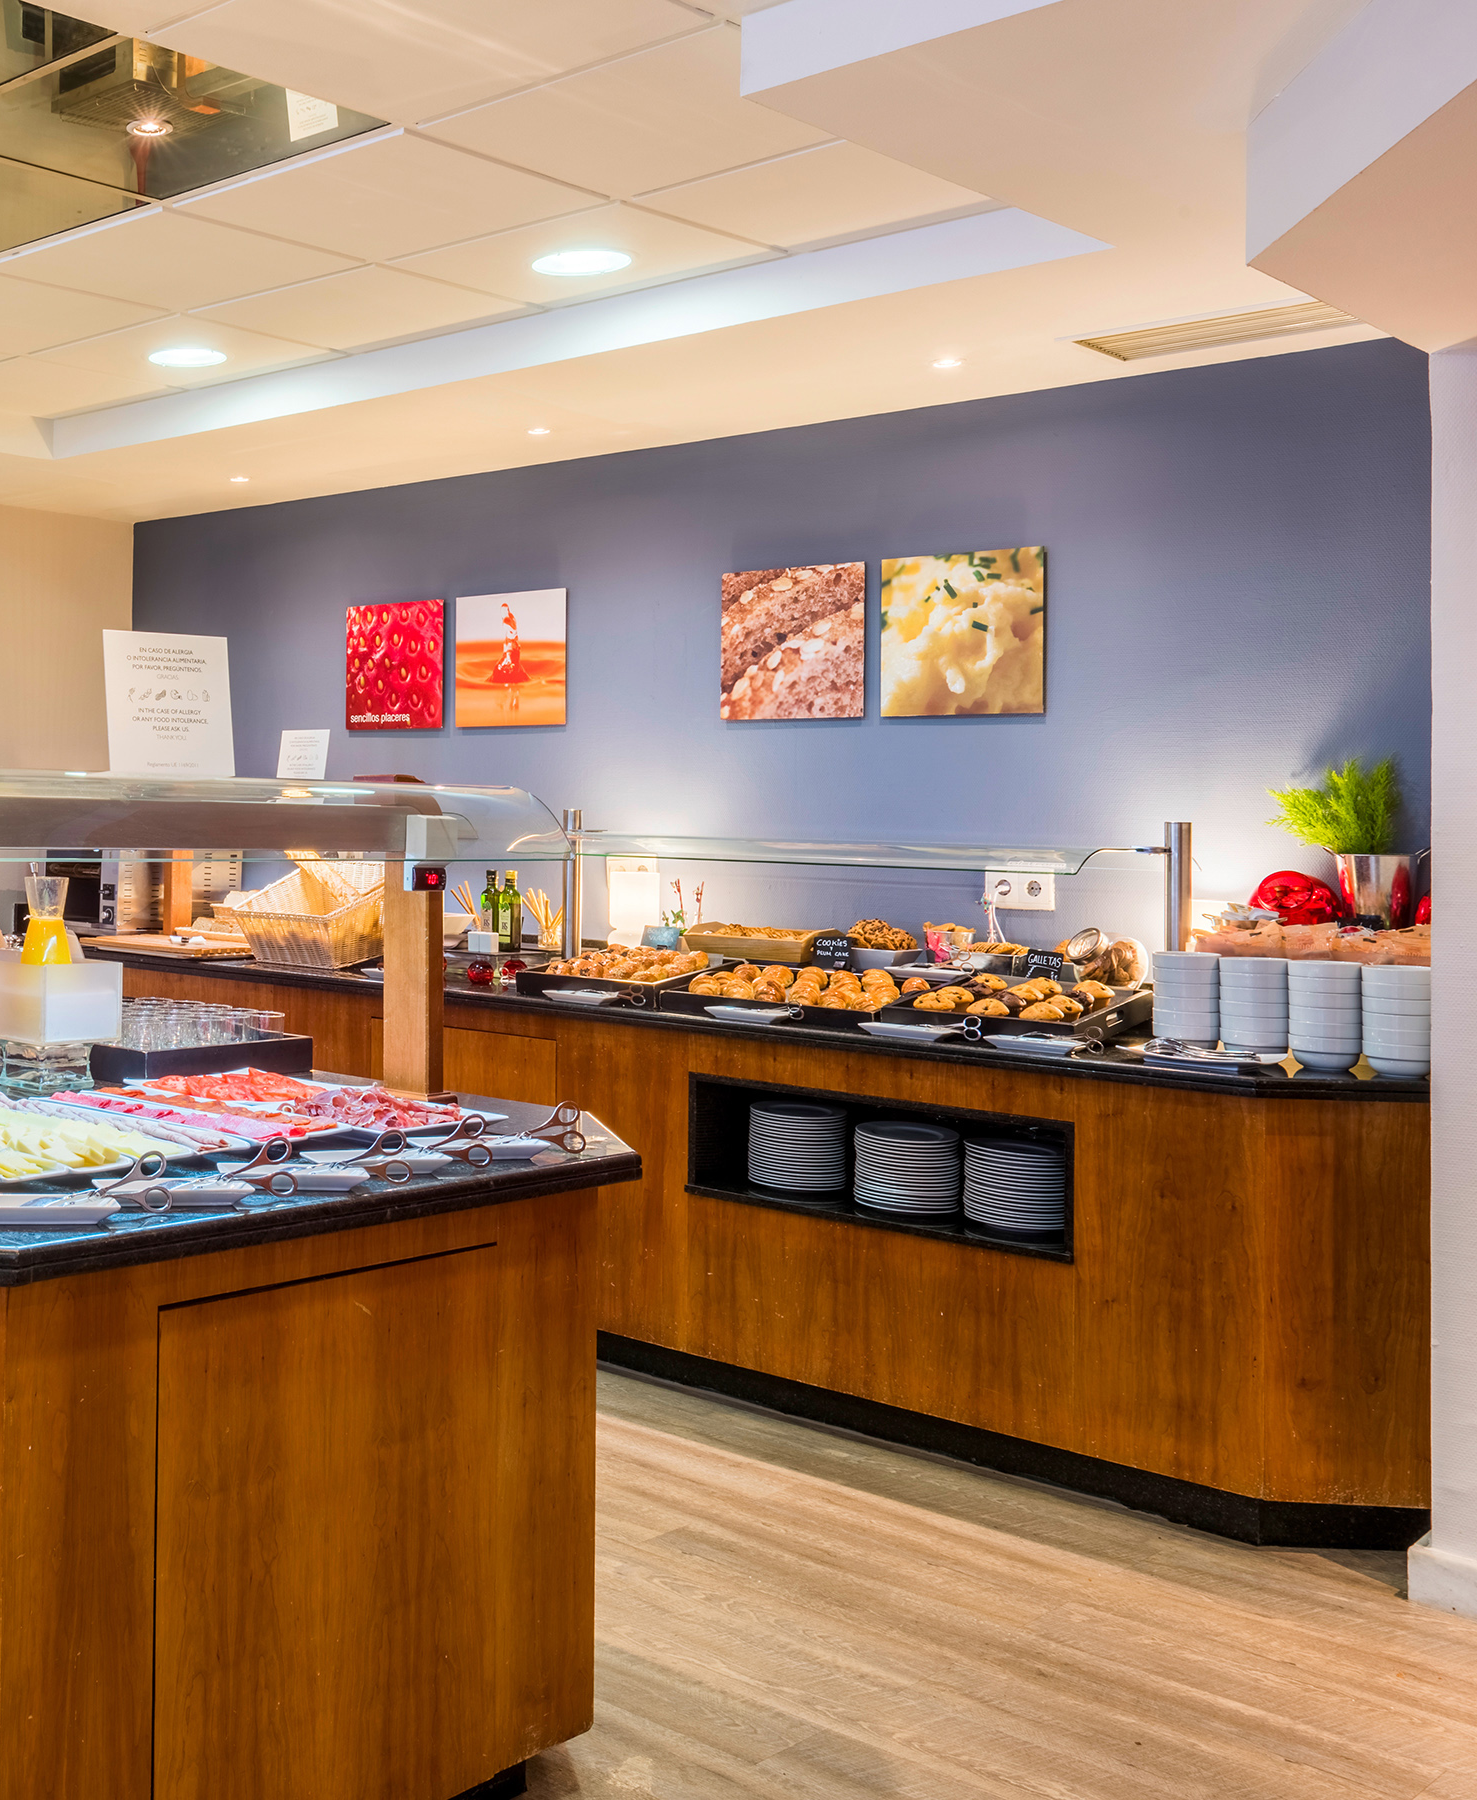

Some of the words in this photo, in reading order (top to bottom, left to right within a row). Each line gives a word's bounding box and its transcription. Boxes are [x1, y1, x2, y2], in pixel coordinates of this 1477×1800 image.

[132, 655, 171, 663] INTOLERANCIA
[350, 712, 379, 723] sencillos
[380, 712, 410, 724] placeres
[1027, 953, 1063, 969] GALLETAS
